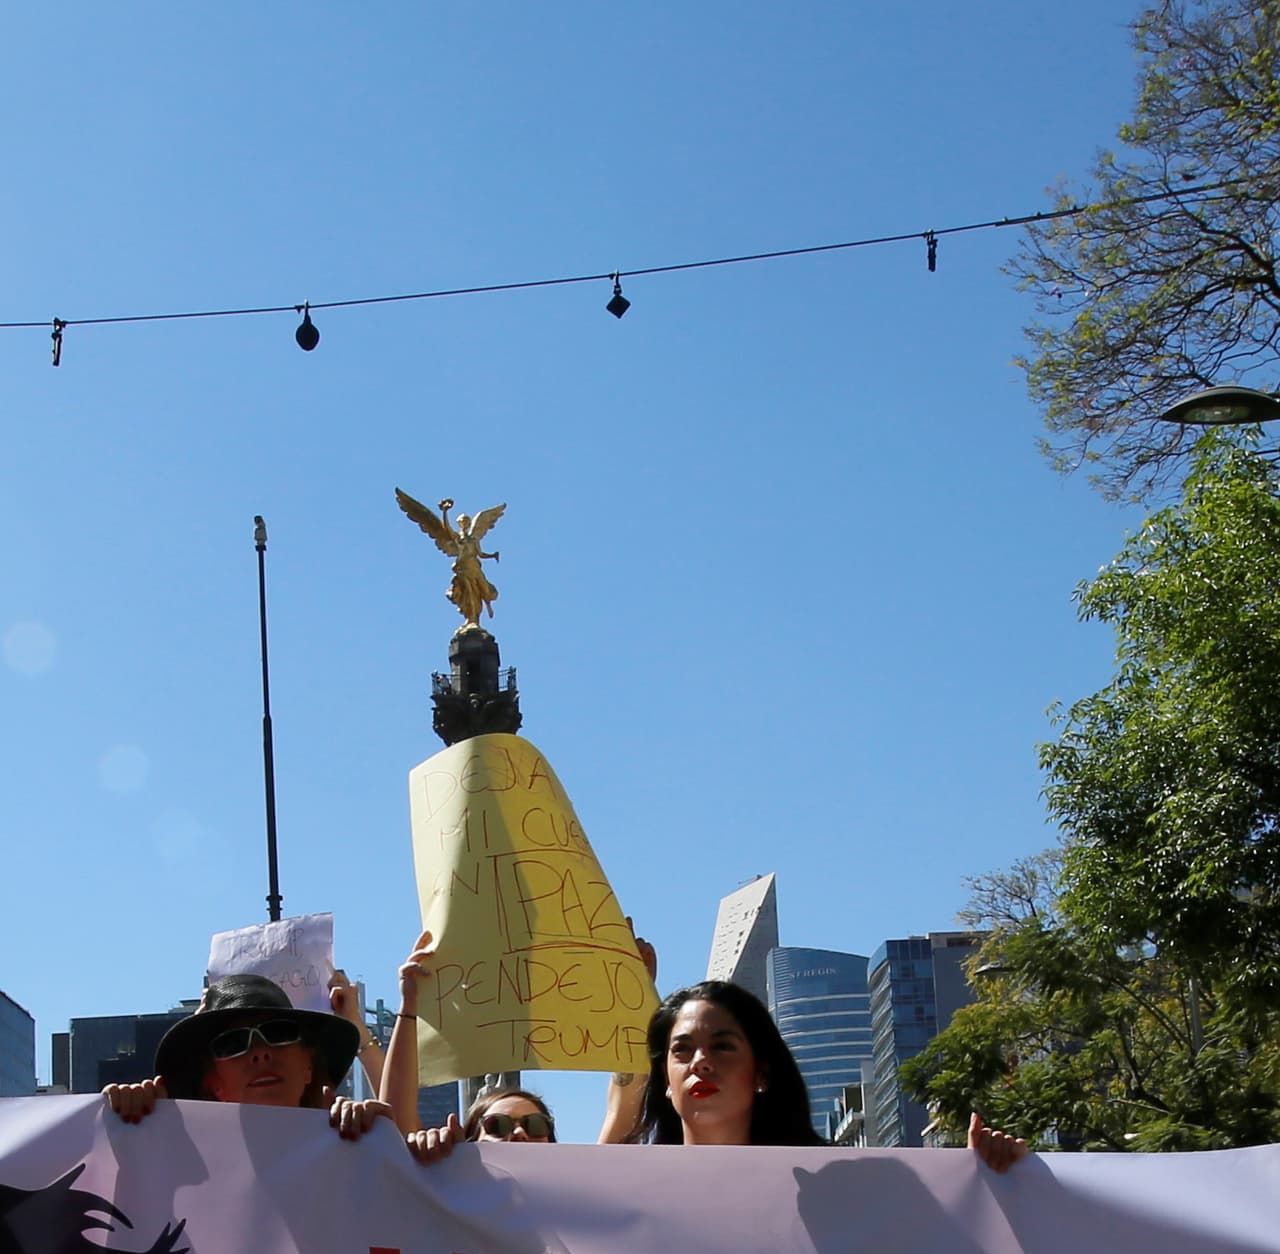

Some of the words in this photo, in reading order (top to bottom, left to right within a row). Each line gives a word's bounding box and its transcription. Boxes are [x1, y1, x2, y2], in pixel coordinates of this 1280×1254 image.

[512, 859, 629, 940] PAZ
[434, 955, 645, 1030] PENDEJO
[476, 1018, 649, 1063] TRUMP
